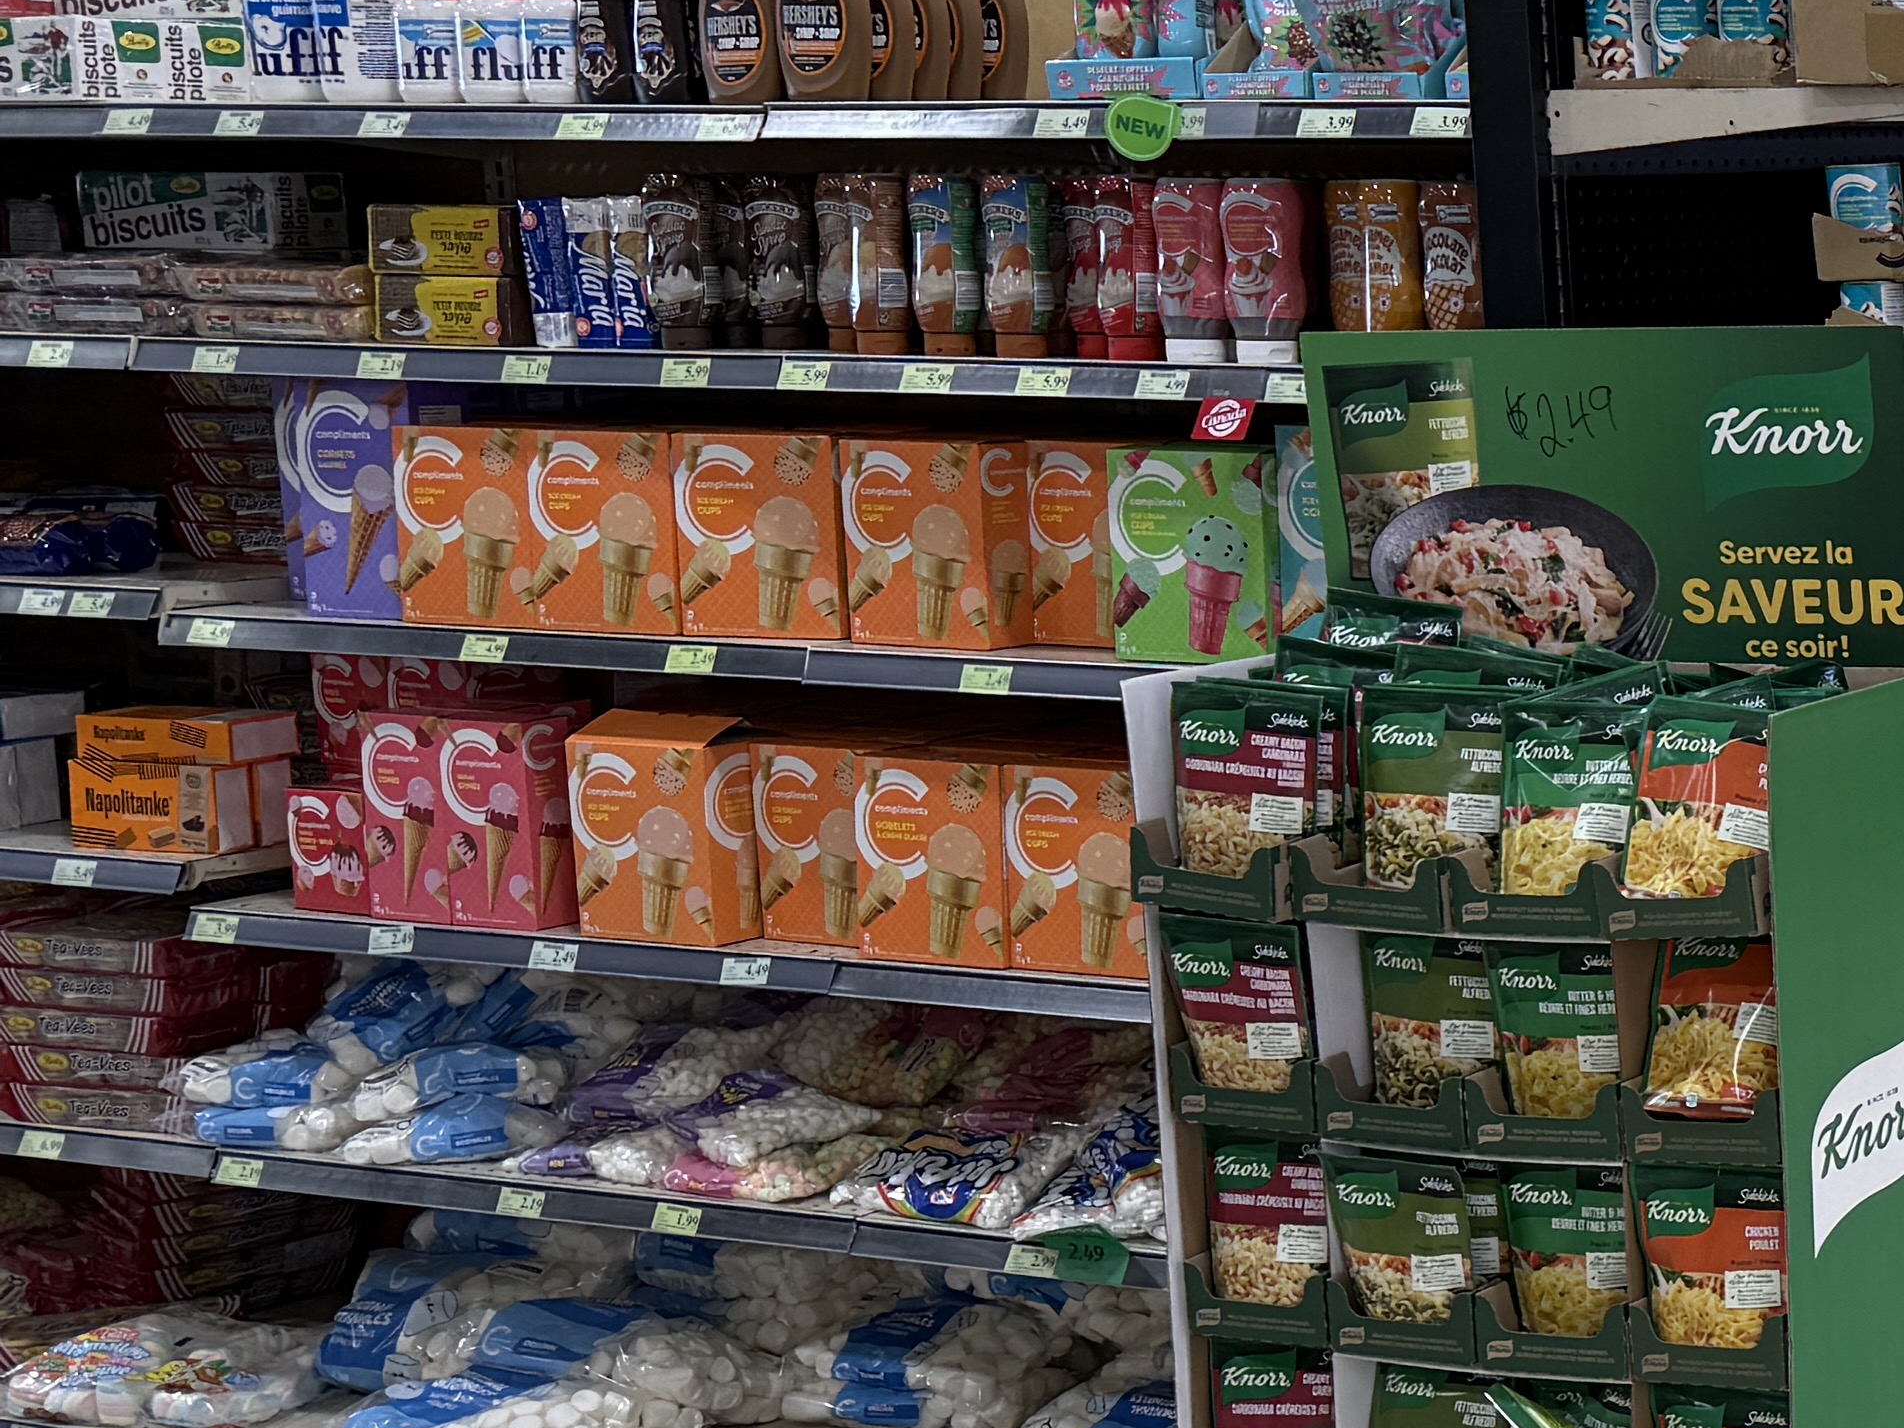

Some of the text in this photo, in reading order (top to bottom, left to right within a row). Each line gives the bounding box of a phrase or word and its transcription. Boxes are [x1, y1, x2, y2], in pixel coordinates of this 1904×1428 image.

[783, 4, 838, 26] HERSHEY'S
[82, 19, 98, 100] biscuits
[103, 42, 118, 100] pilote
[168, 24, 186, 101] biscuits
[188, 46, 203, 101] pilote
[1061, 115, 1088, 131] 4.49
[1115, 113, 1167, 141] NEW
[1326, 115, 1353, 131] 3.99
[1439, 115, 1468, 131] 3.99
[93, 174, 155, 214] pilot
[91, 204, 206, 246] biscuits
[575, 240, 614, 328] Maria
[613, 240, 646, 328] Maria
[381, 358, 403, 372] 2.19
[526, 362, 548, 377] 1.19
[684, 365, 710, 381] 5.99
[803, 368, 829, 384] 5.99
[926, 372, 952, 387] 5.99
[1042, 374, 1069, 389] 5.99
[1201, 409, 1249, 429] Canada
[1340, 401, 1406, 427] Knorr
[1505, 385, 1619, 458] $2.49
[1705, 406, 1863, 456] Knorr
[1720, 540, 1854, 565] Servez la
[690, 651, 715, 667] 2.49
[1745, 635, 1850, 660] ce soir!
[1180, 720, 1240, 747] Knorr
[1372, 723, 1437, 748] Knorr
[1656, 729, 1721, 755] Knorr
[1515, 738, 1575, 762] Knorr
[84, 786, 173, 819] Napolitanke
[874, 804, 929, 818] compliments
[390, 928, 414, 944] 2.49
[551, 950, 577, 966] 2.49
[1171, 953, 1231, 978] Knorr
[1374, 947, 1427, 974] Knorr
[744, 963, 770, 979] 4.49
[1498, 967, 1558, 991] Knorr
[241, 1164, 262, 1180] 2.19
[1214, 1155, 1272, 1179] Knorr
[520, 1195, 543, 1212] 2.19
[1337, 1183, 1396, 1209] Knorr
[1508, 1182, 1573, 1206] Knorr
[1646, 1200, 1711, 1225] Knorr
[1068, 1242, 1106, 1263] 2.49
[1222, 1366, 1292, 1388] Knorr
[1385, 1373, 1436, 1399] Knorr
